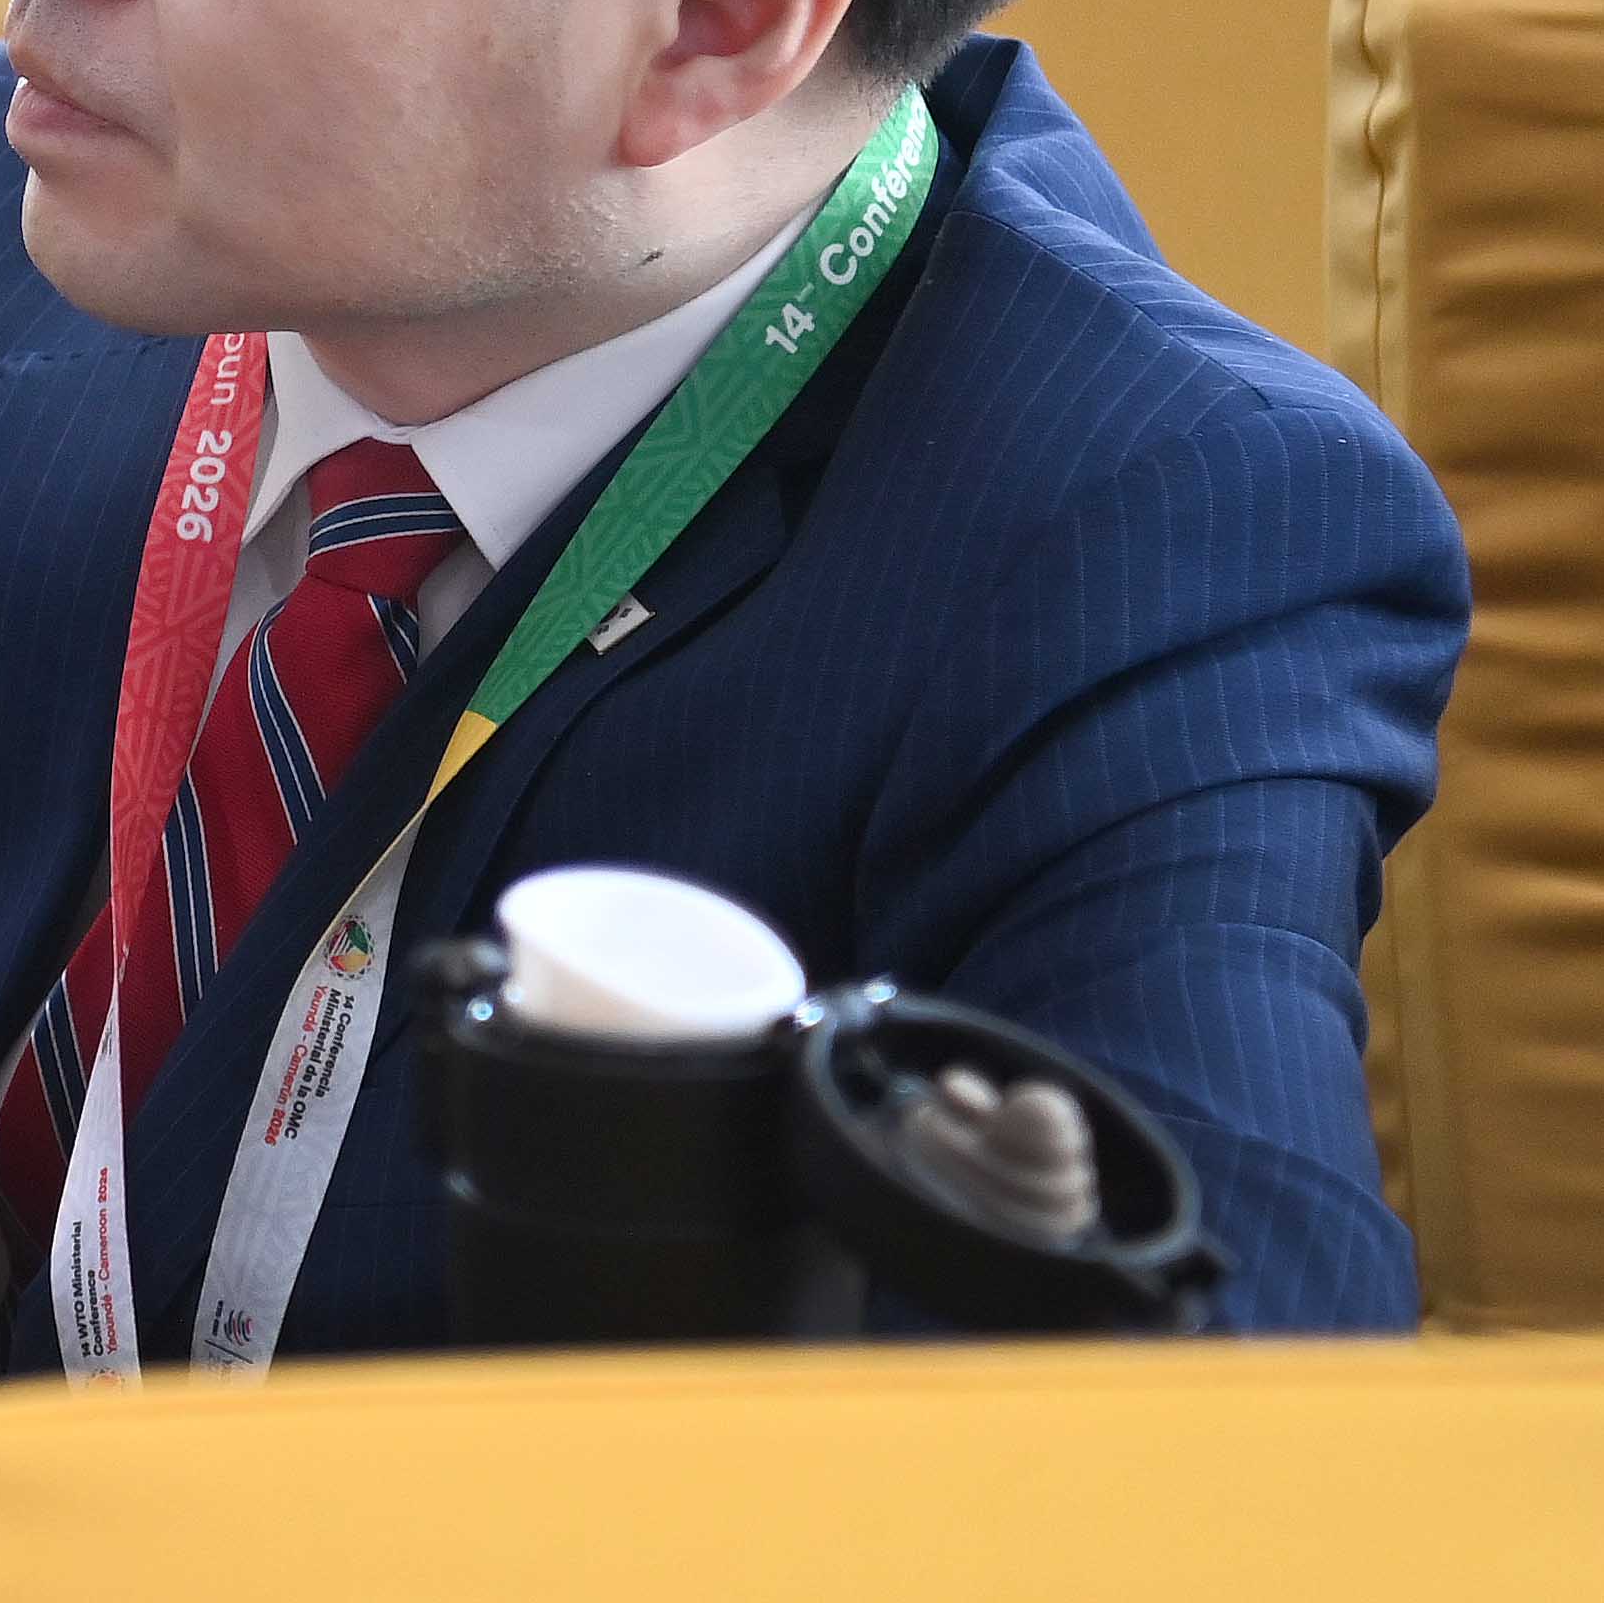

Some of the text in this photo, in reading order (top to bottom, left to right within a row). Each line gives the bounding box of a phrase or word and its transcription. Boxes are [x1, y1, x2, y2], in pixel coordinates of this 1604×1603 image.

[176, 430, 233, 544] 2026
[284, 988, 342, 1140] Ministerial de la OMC
[315, 995, 355, 1098] 14 Conferencia
[264, 1108, 286, 1146] 2026
[71, 1221, 84, 1298] Ministerial
[98, 1208, 110, 1281] Cameroon
[74, 1300, 88, 1339] WTO
[88, 1269, 104, 1357] Conference
